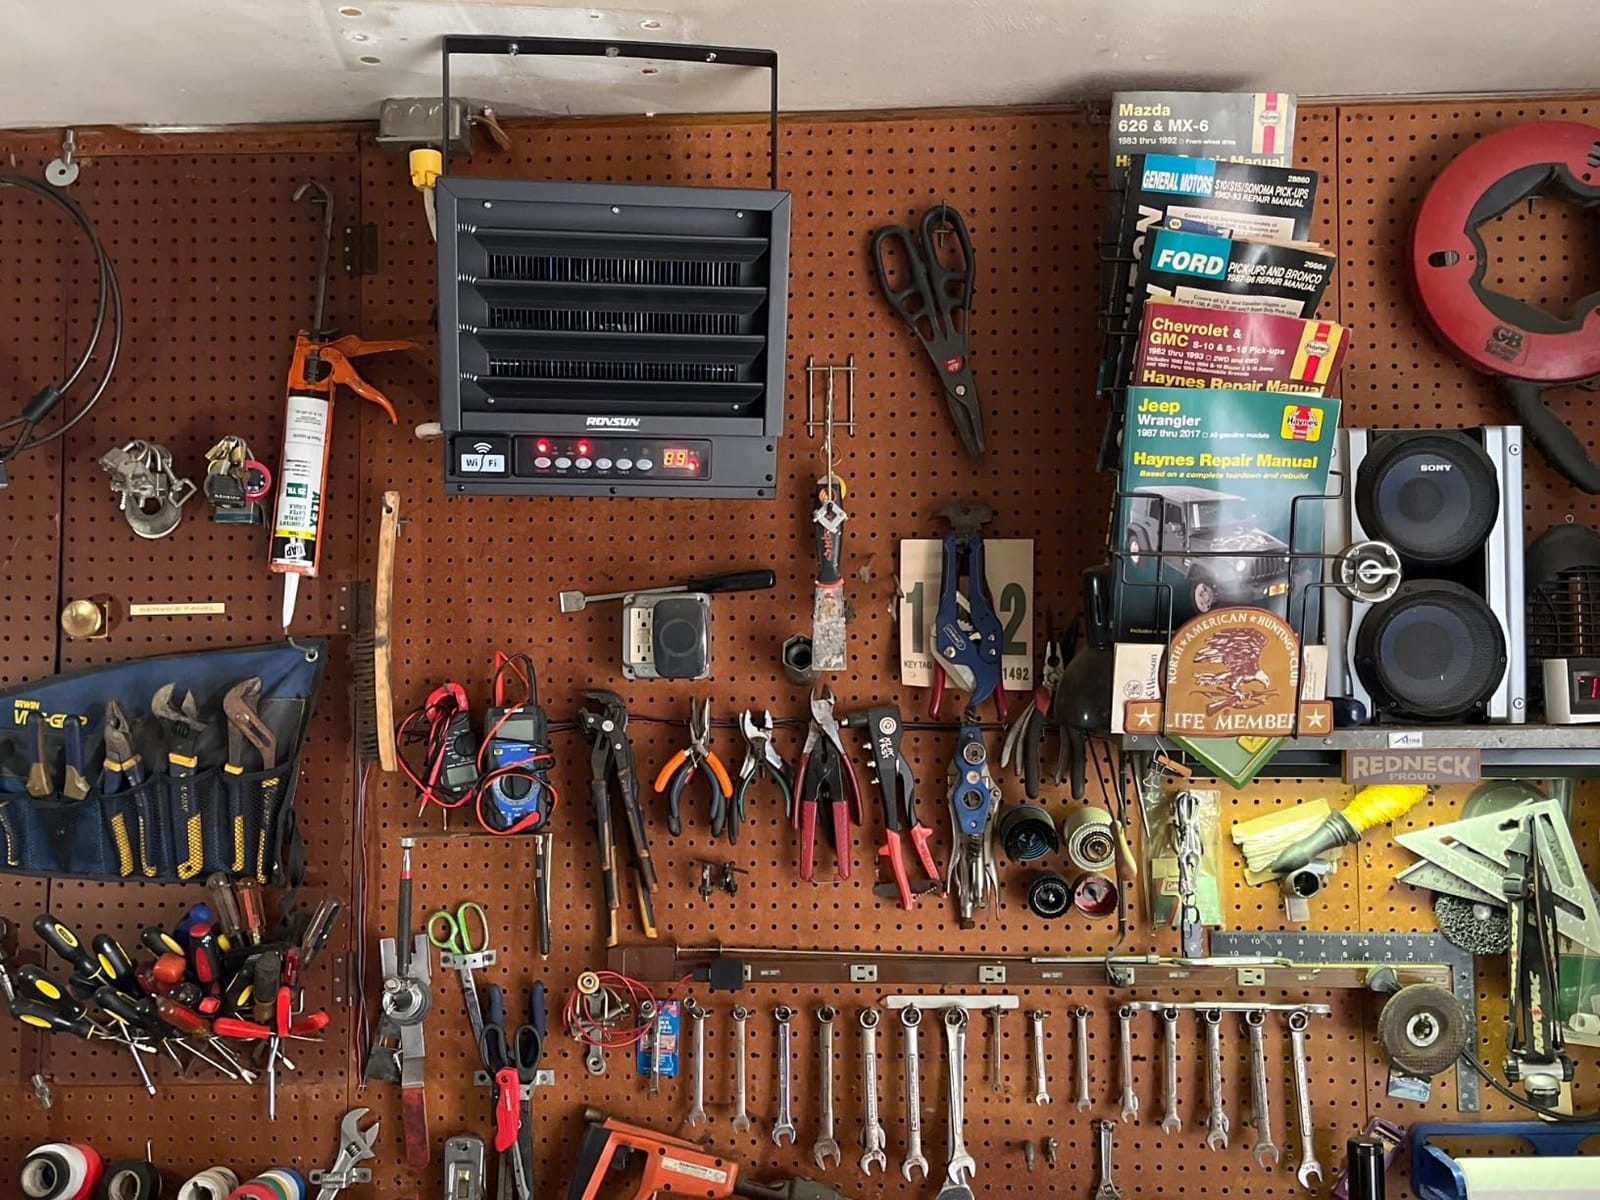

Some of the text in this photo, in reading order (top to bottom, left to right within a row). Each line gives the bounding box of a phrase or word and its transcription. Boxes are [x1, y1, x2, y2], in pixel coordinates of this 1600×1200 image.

[1119, 103, 1171, 117] Mazda
[1118, 119, 1209, 132] 626 & MX-6
[1118, 137, 1137, 145] 1983
[1139, 137, 1156, 145] thru
[1158, 137, 1177, 145] 1992
[1143, 171, 1214, 194] GENERAL MOTORS
[1243, 193, 1270, 204] REPAIR
[1271, 196, 1304, 208] MANUAL
[1275, 187, 1309, 200] PICK-UPS
[1156, 248, 1224, 274] FORD
[1228, 261, 1322, 284] PICK-UPS AND BRONCO
[1256, 276, 1283, 285] REPAIR
[1283, 279, 1316, 292] MANUAL
[1151, 317, 1242, 339] Chevrolet &
[1150, 331, 1189, 347] GMC
[1192, 341, 1214, 350] S-10
[1226, 346, 1247, 354] S-15
[1248, 346, 1285, 356] Pick-ups
[1148, 347, 1166, 355] 1982
[1167, 349, 1184, 357] thru
[1186, 351, 1204, 359] 1993
[1143, 369, 1325, 394] Haynes Repair Manual
[1138, 398, 1180, 415] Jeep
[586, 417, 640, 427] ROVSUN
[1137, 413, 1201, 428] Wrangler
[1136, 429, 1158, 437] 1987
[1159, 429, 1178, 438] thru
[1179, 429, 1200, 438] 2017
[464, 458, 497, 467] Wi Fi
[1134, 451, 1318, 469] Haynes Repair Manual
[1139, 470, 1165, 478] Based
[1186, 471, 1224, 480] complete
[1280, 472, 1309, 480] rebuild
[1420, 464, 1452, 472] SONY
[1168, 645, 1184, 685] NORTH
[1184, 613, 1247, 641] AMERICAN
[1257, 615, 1294, 651] HUNTING
[904, 660, 918, 669] KEY
[1002, 667, 1030, 680] 1492
[1352, 755, 1472, 780] REDNECK
[1389, 772, 1437, 781] PROUD
[1529, 970, 1545, 1055] RAYOVAC
